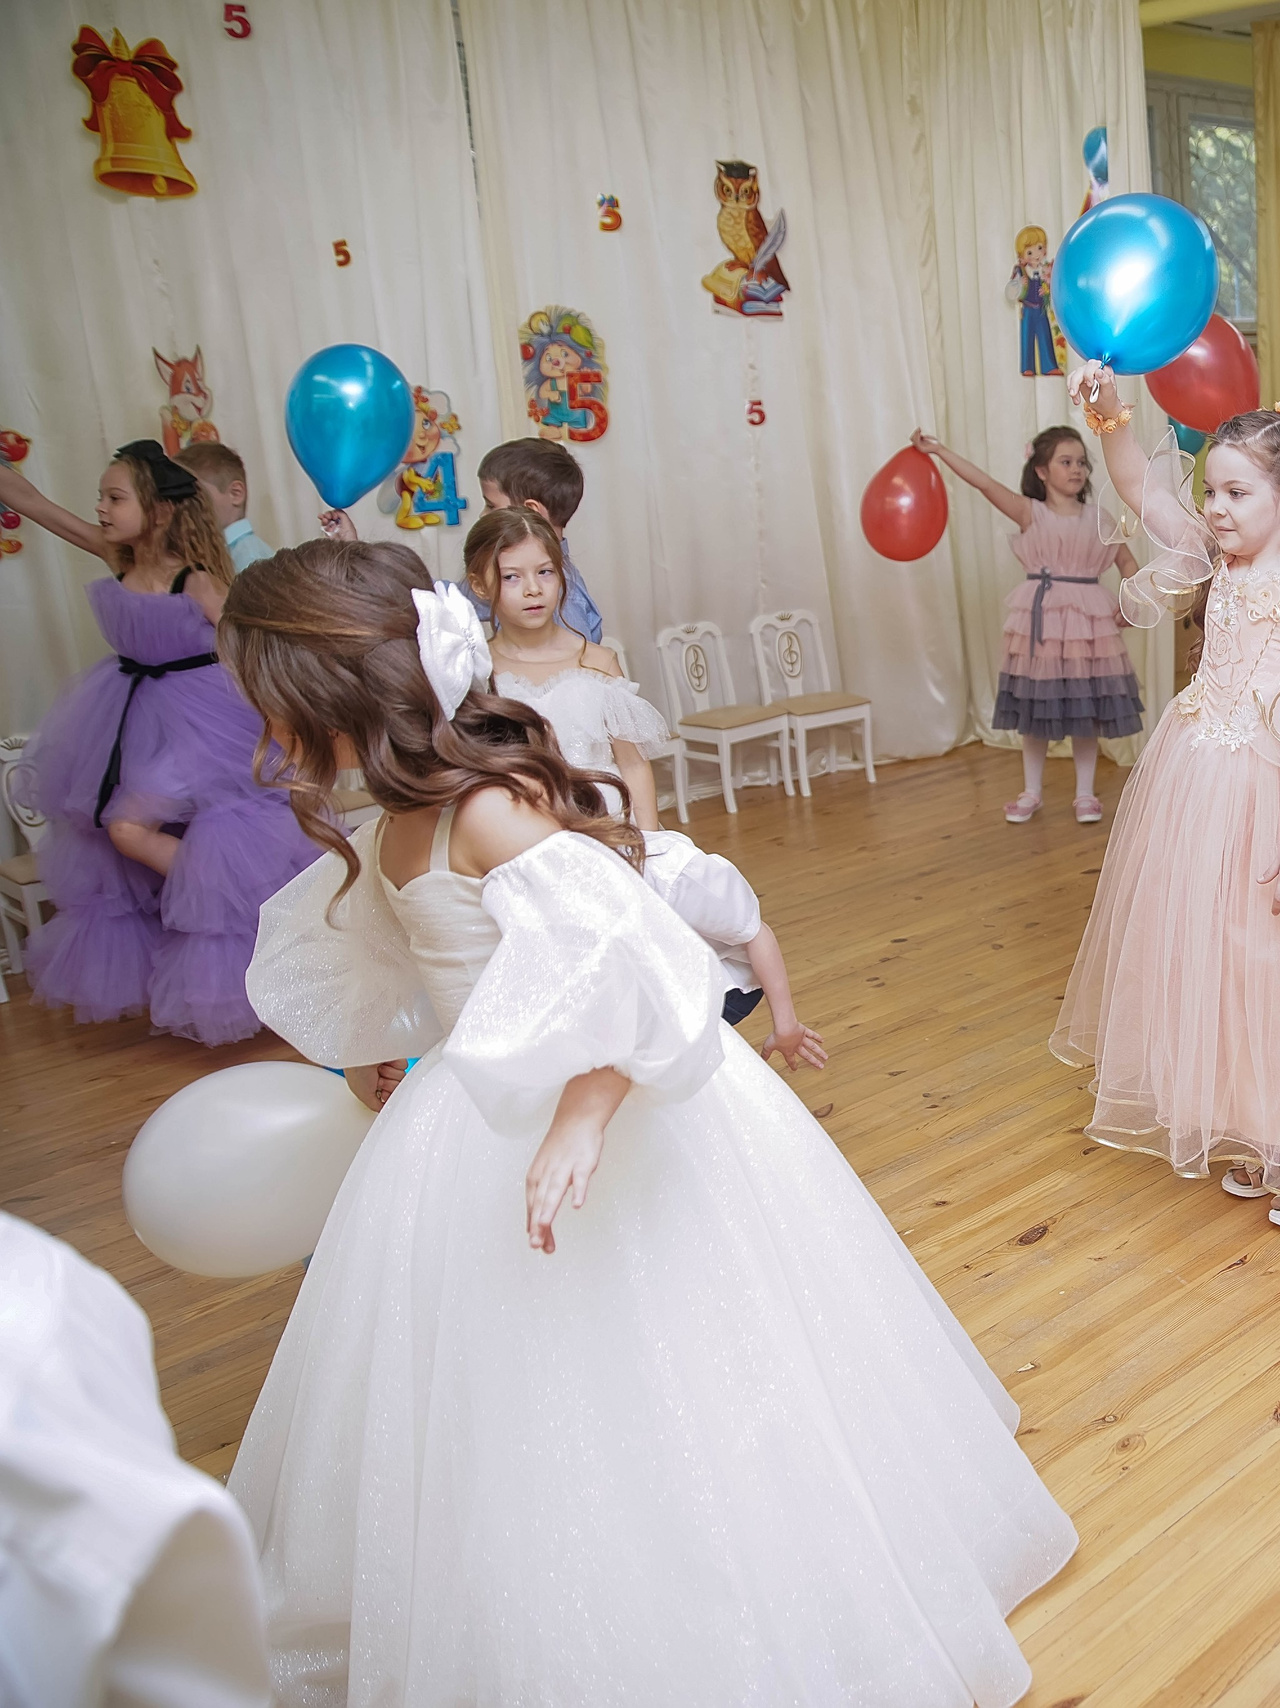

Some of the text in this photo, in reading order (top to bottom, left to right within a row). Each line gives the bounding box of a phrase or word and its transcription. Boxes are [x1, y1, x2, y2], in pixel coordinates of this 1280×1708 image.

[223, 3, 252, 39] 5
[599, 196, 622, 231] 5
[332, 239, 352, 267] 5
[566, 370, 610, 442] 5
[745, 400, 766, 426] 5
[413, 452, 467, 526] 4
